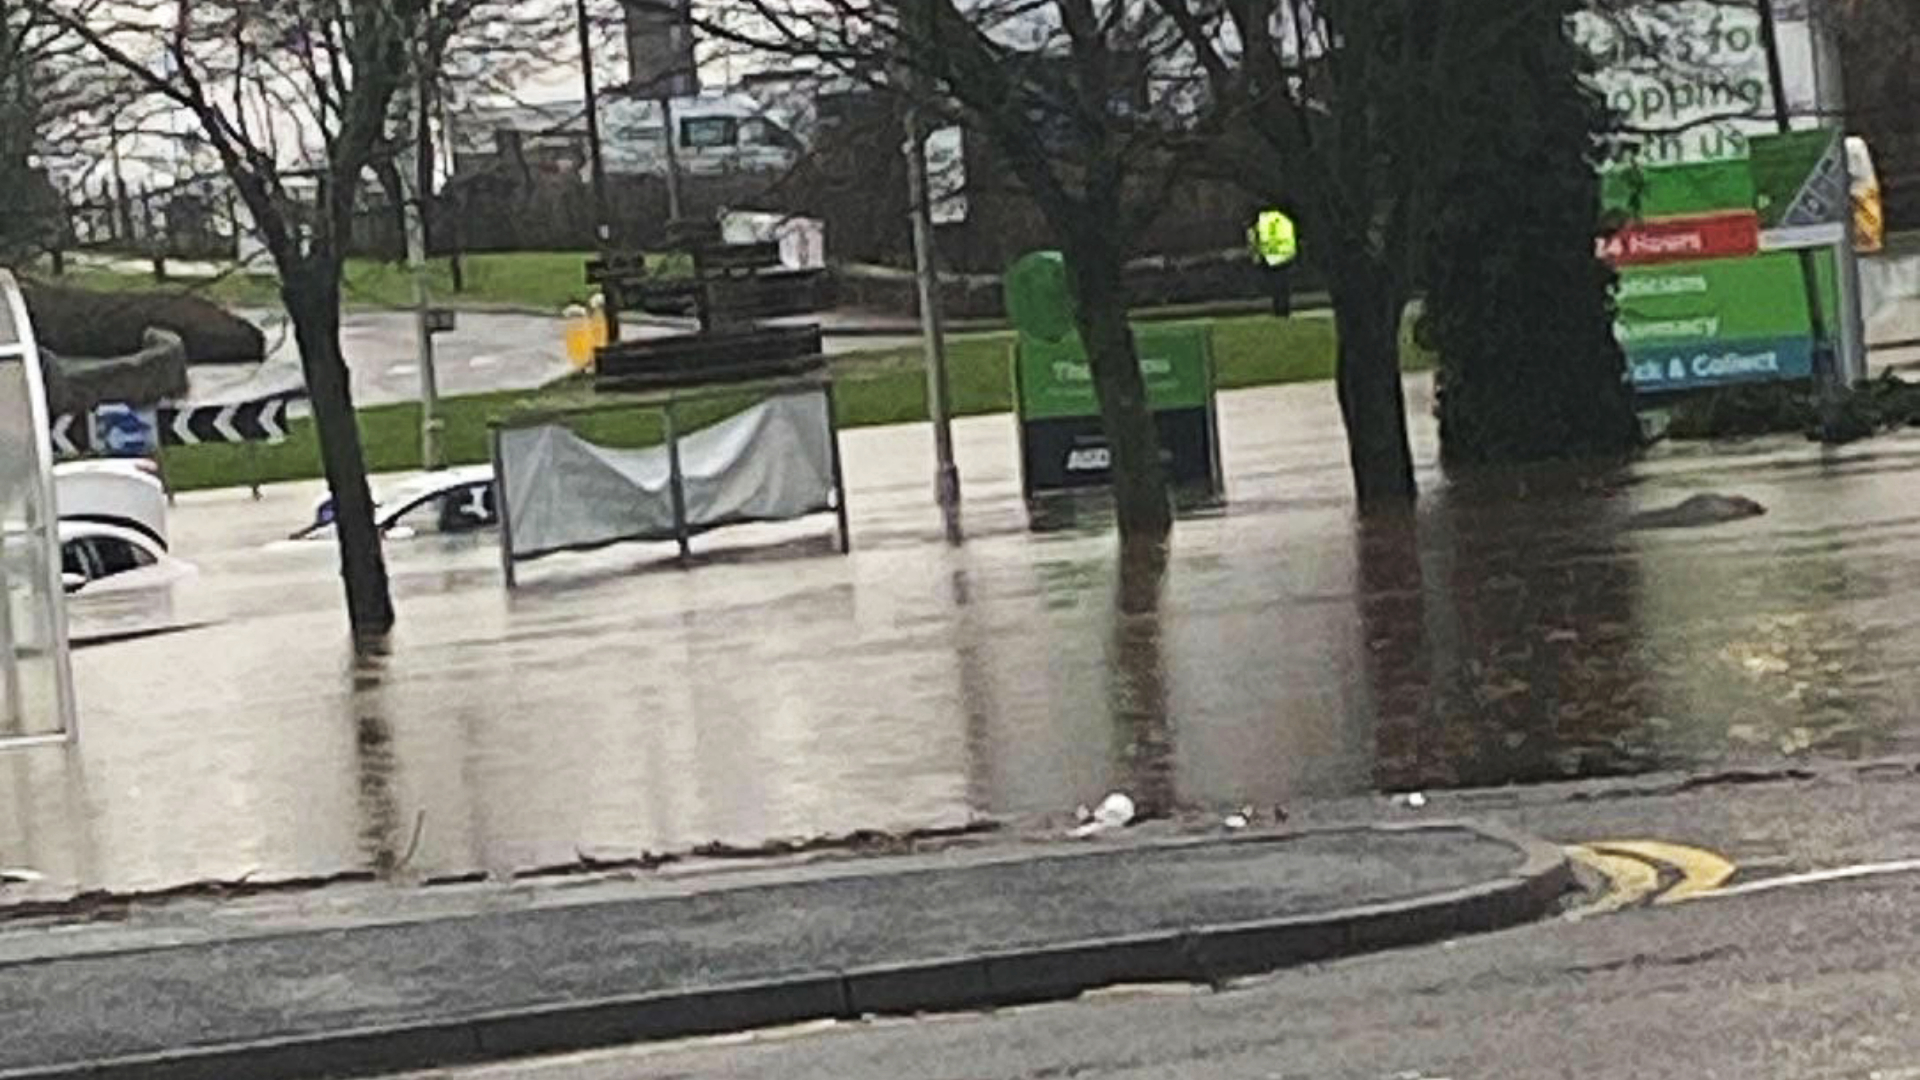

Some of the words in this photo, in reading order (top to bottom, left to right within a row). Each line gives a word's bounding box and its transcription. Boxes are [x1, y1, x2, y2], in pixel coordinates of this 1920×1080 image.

[1612, 78, 1763, 121] opping
[1629, 232, 1702, 254] Hours
[1668, 357, 1686, 379] &
[1692, 352, 1779, 378] Collect
[1067, 448, 1111, 470] ASD
